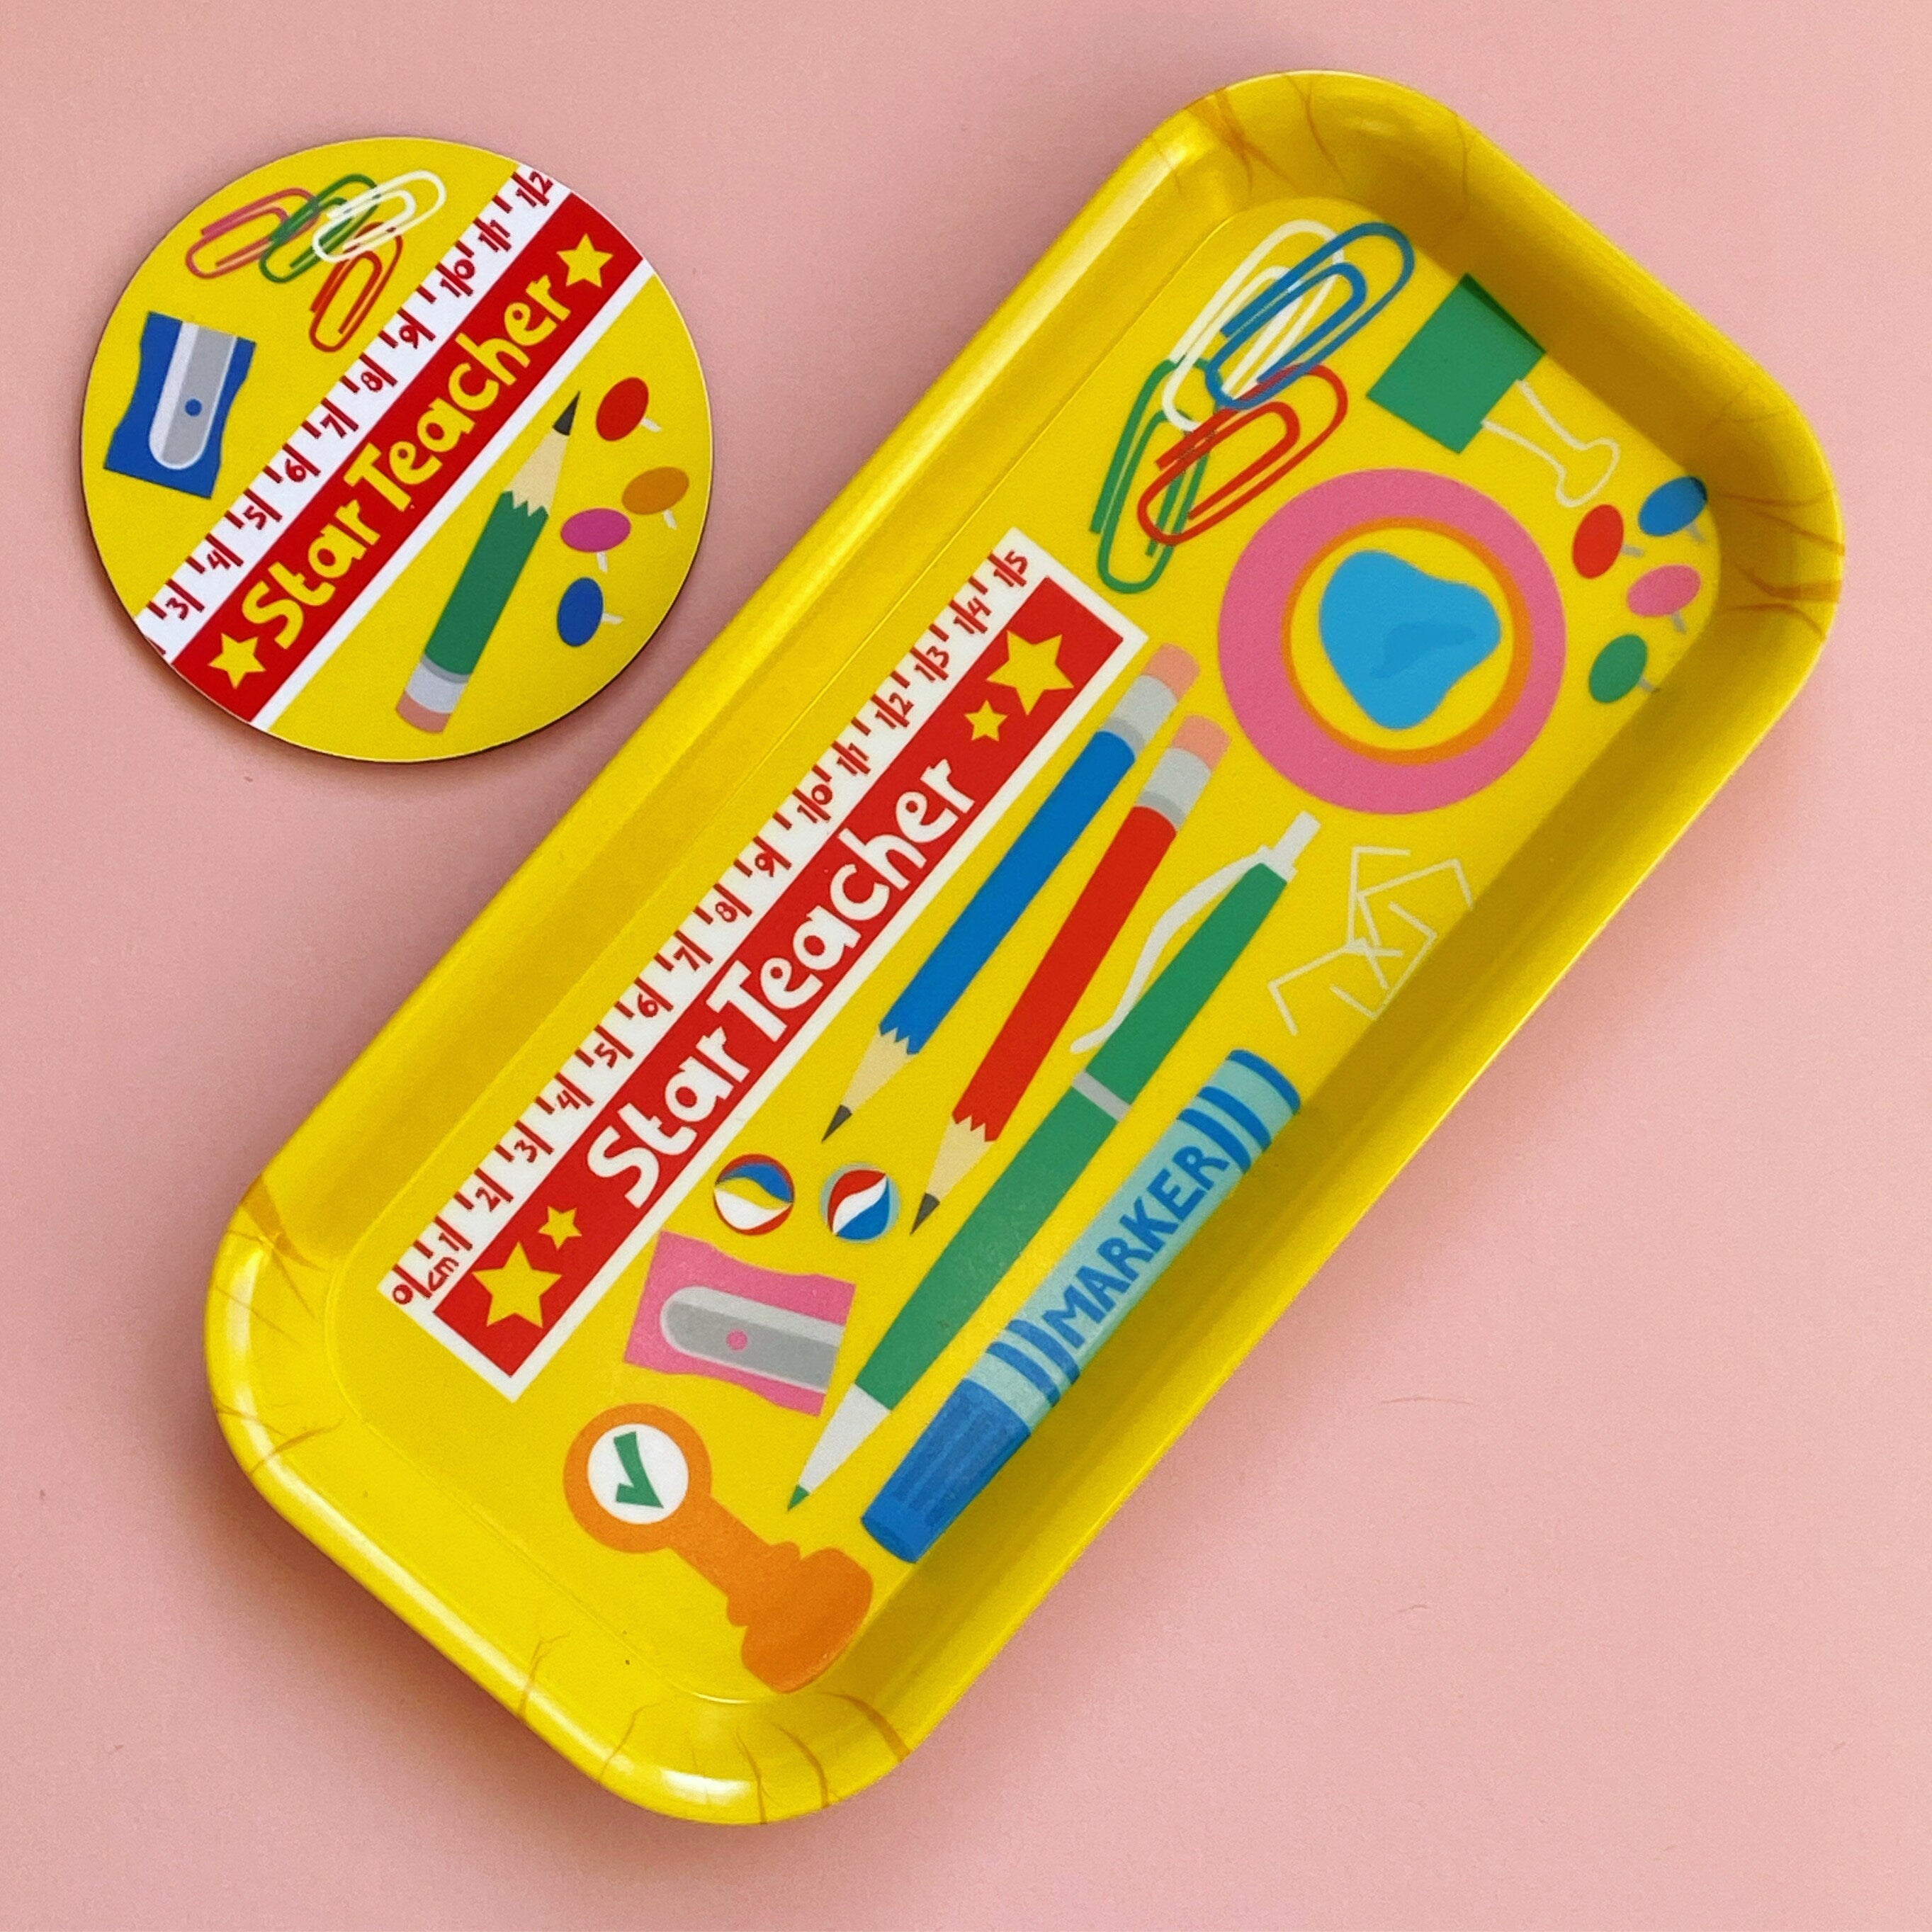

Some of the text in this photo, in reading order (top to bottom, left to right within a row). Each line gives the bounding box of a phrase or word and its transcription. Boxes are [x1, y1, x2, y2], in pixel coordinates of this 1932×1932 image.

[165, 171, 553, 619] 3 4 5 6 7 8 9 10 11 12
[242, 274, 572, 650] Star Teacher
[392, 1283, 413, 1304] 0
[428, 1257, 459, 1292] cm
[475, 1187, 500, 1212] 2
[515, 1140, 538, 1163] 3
[555, 1090, 580, 1110] 4
[595, 1043, 618, 1069] 5
[638, 994, 659, 1017] 6
[674, 947, 701, 971] 7
[715, 901, 738, 922] 8
[755, 852, 774, 877] 9
[797, 784, 832, 823] 10
[837, 742, 869, 775] 11
[875, 691, 914, 730] 12
[915, 645, 949, 683] 13
[954, 597, 993, 635] 14
[993, 550, 1029, 587] 15
[588, 759, 975, 1209] Star Teacher
[1042, 1146, 1230, 1349] MARKER
